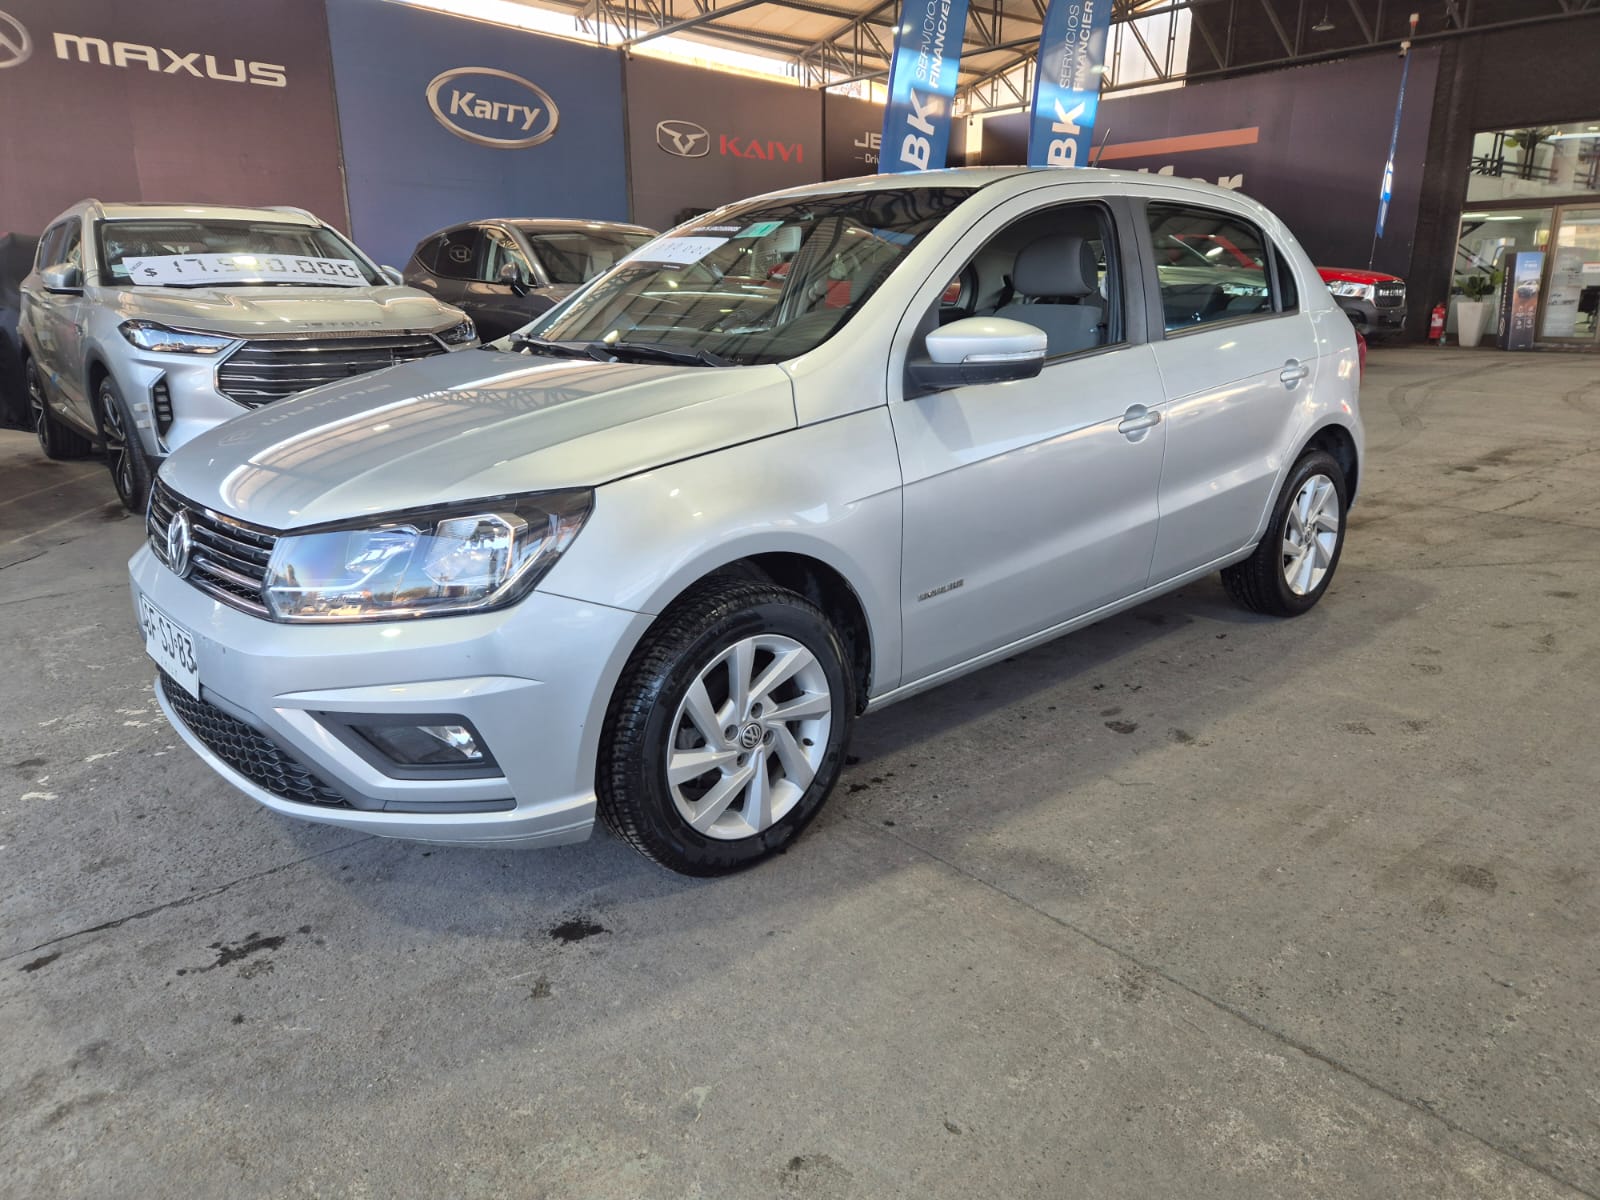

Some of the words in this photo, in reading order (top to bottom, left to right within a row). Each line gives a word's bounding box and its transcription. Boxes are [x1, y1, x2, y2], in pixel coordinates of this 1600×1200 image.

[53, 32, 287, 87] MAXUS
[915, 0, 938, 80] SERVICIO
[1060, 5, 1080, 88] SERVICIOS
[450, 89, 541, 130] Karry
[900, 88, 935, 171] BK
[1047, 98, 1085, 167] BK
